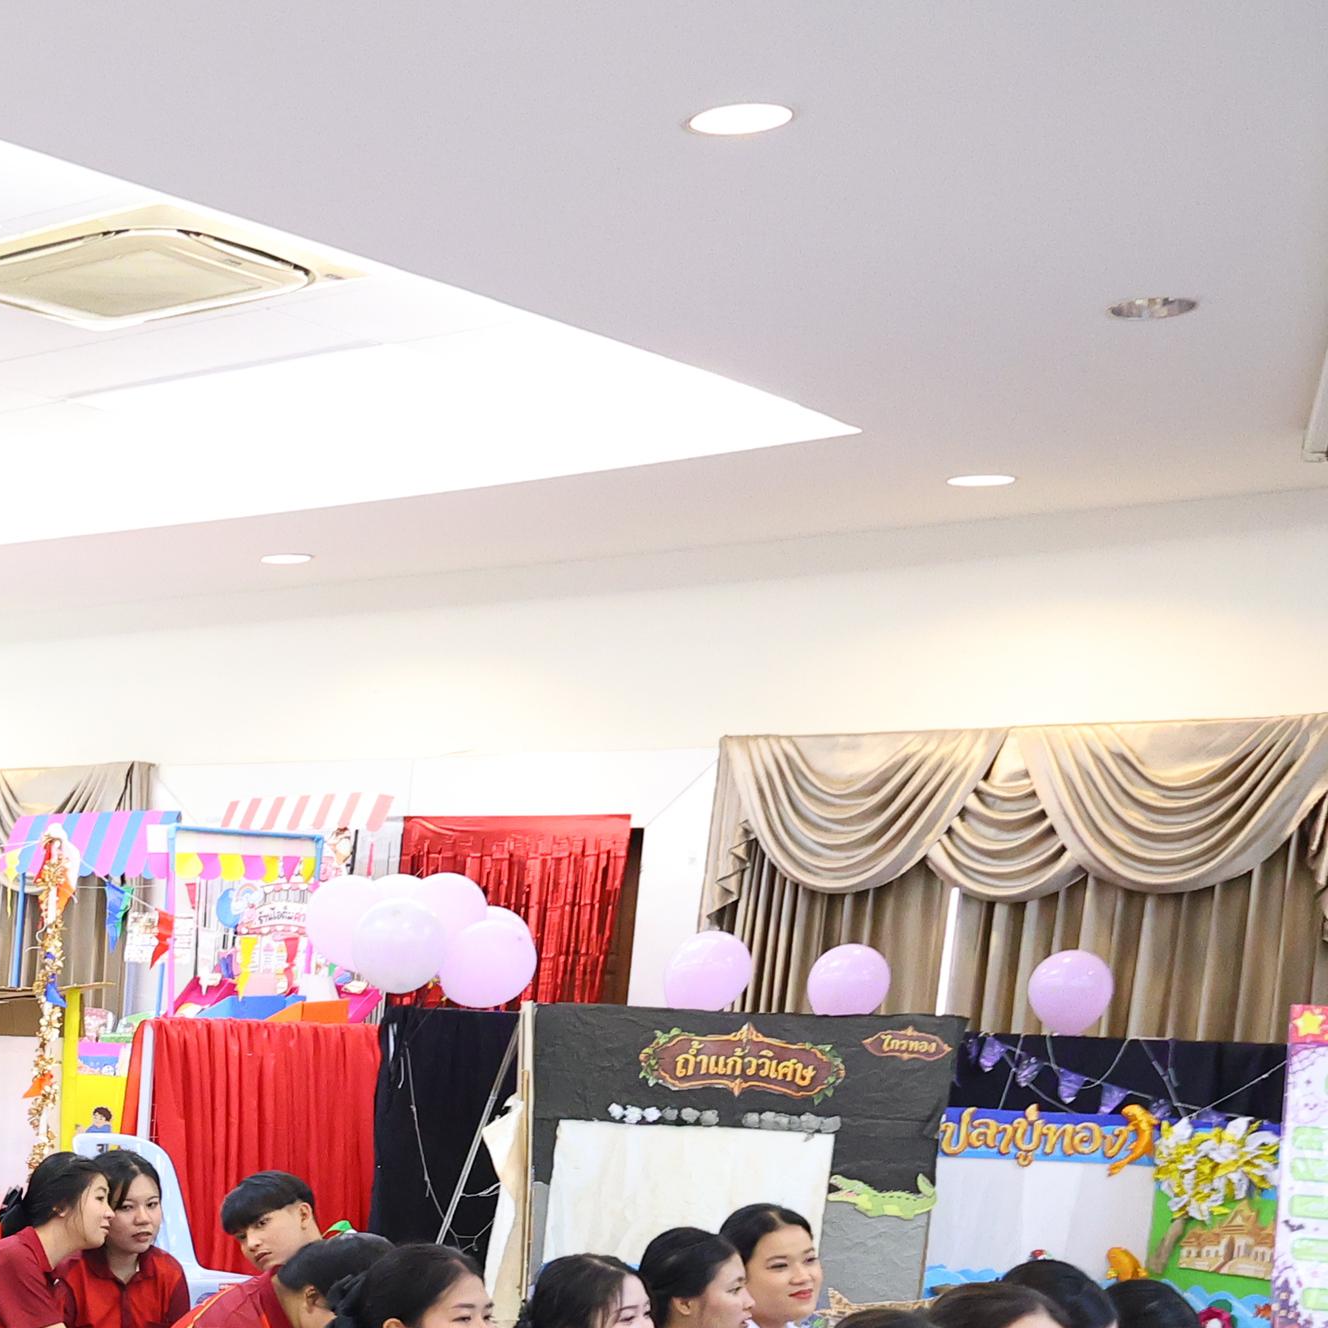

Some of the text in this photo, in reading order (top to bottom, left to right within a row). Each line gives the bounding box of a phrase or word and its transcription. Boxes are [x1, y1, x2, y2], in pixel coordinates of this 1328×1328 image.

[675, 1040, 817, 1087] ถ้ำแก้ววิเศษ
[940, 1103, 1135, 1168] ปลาบู่ทอง
